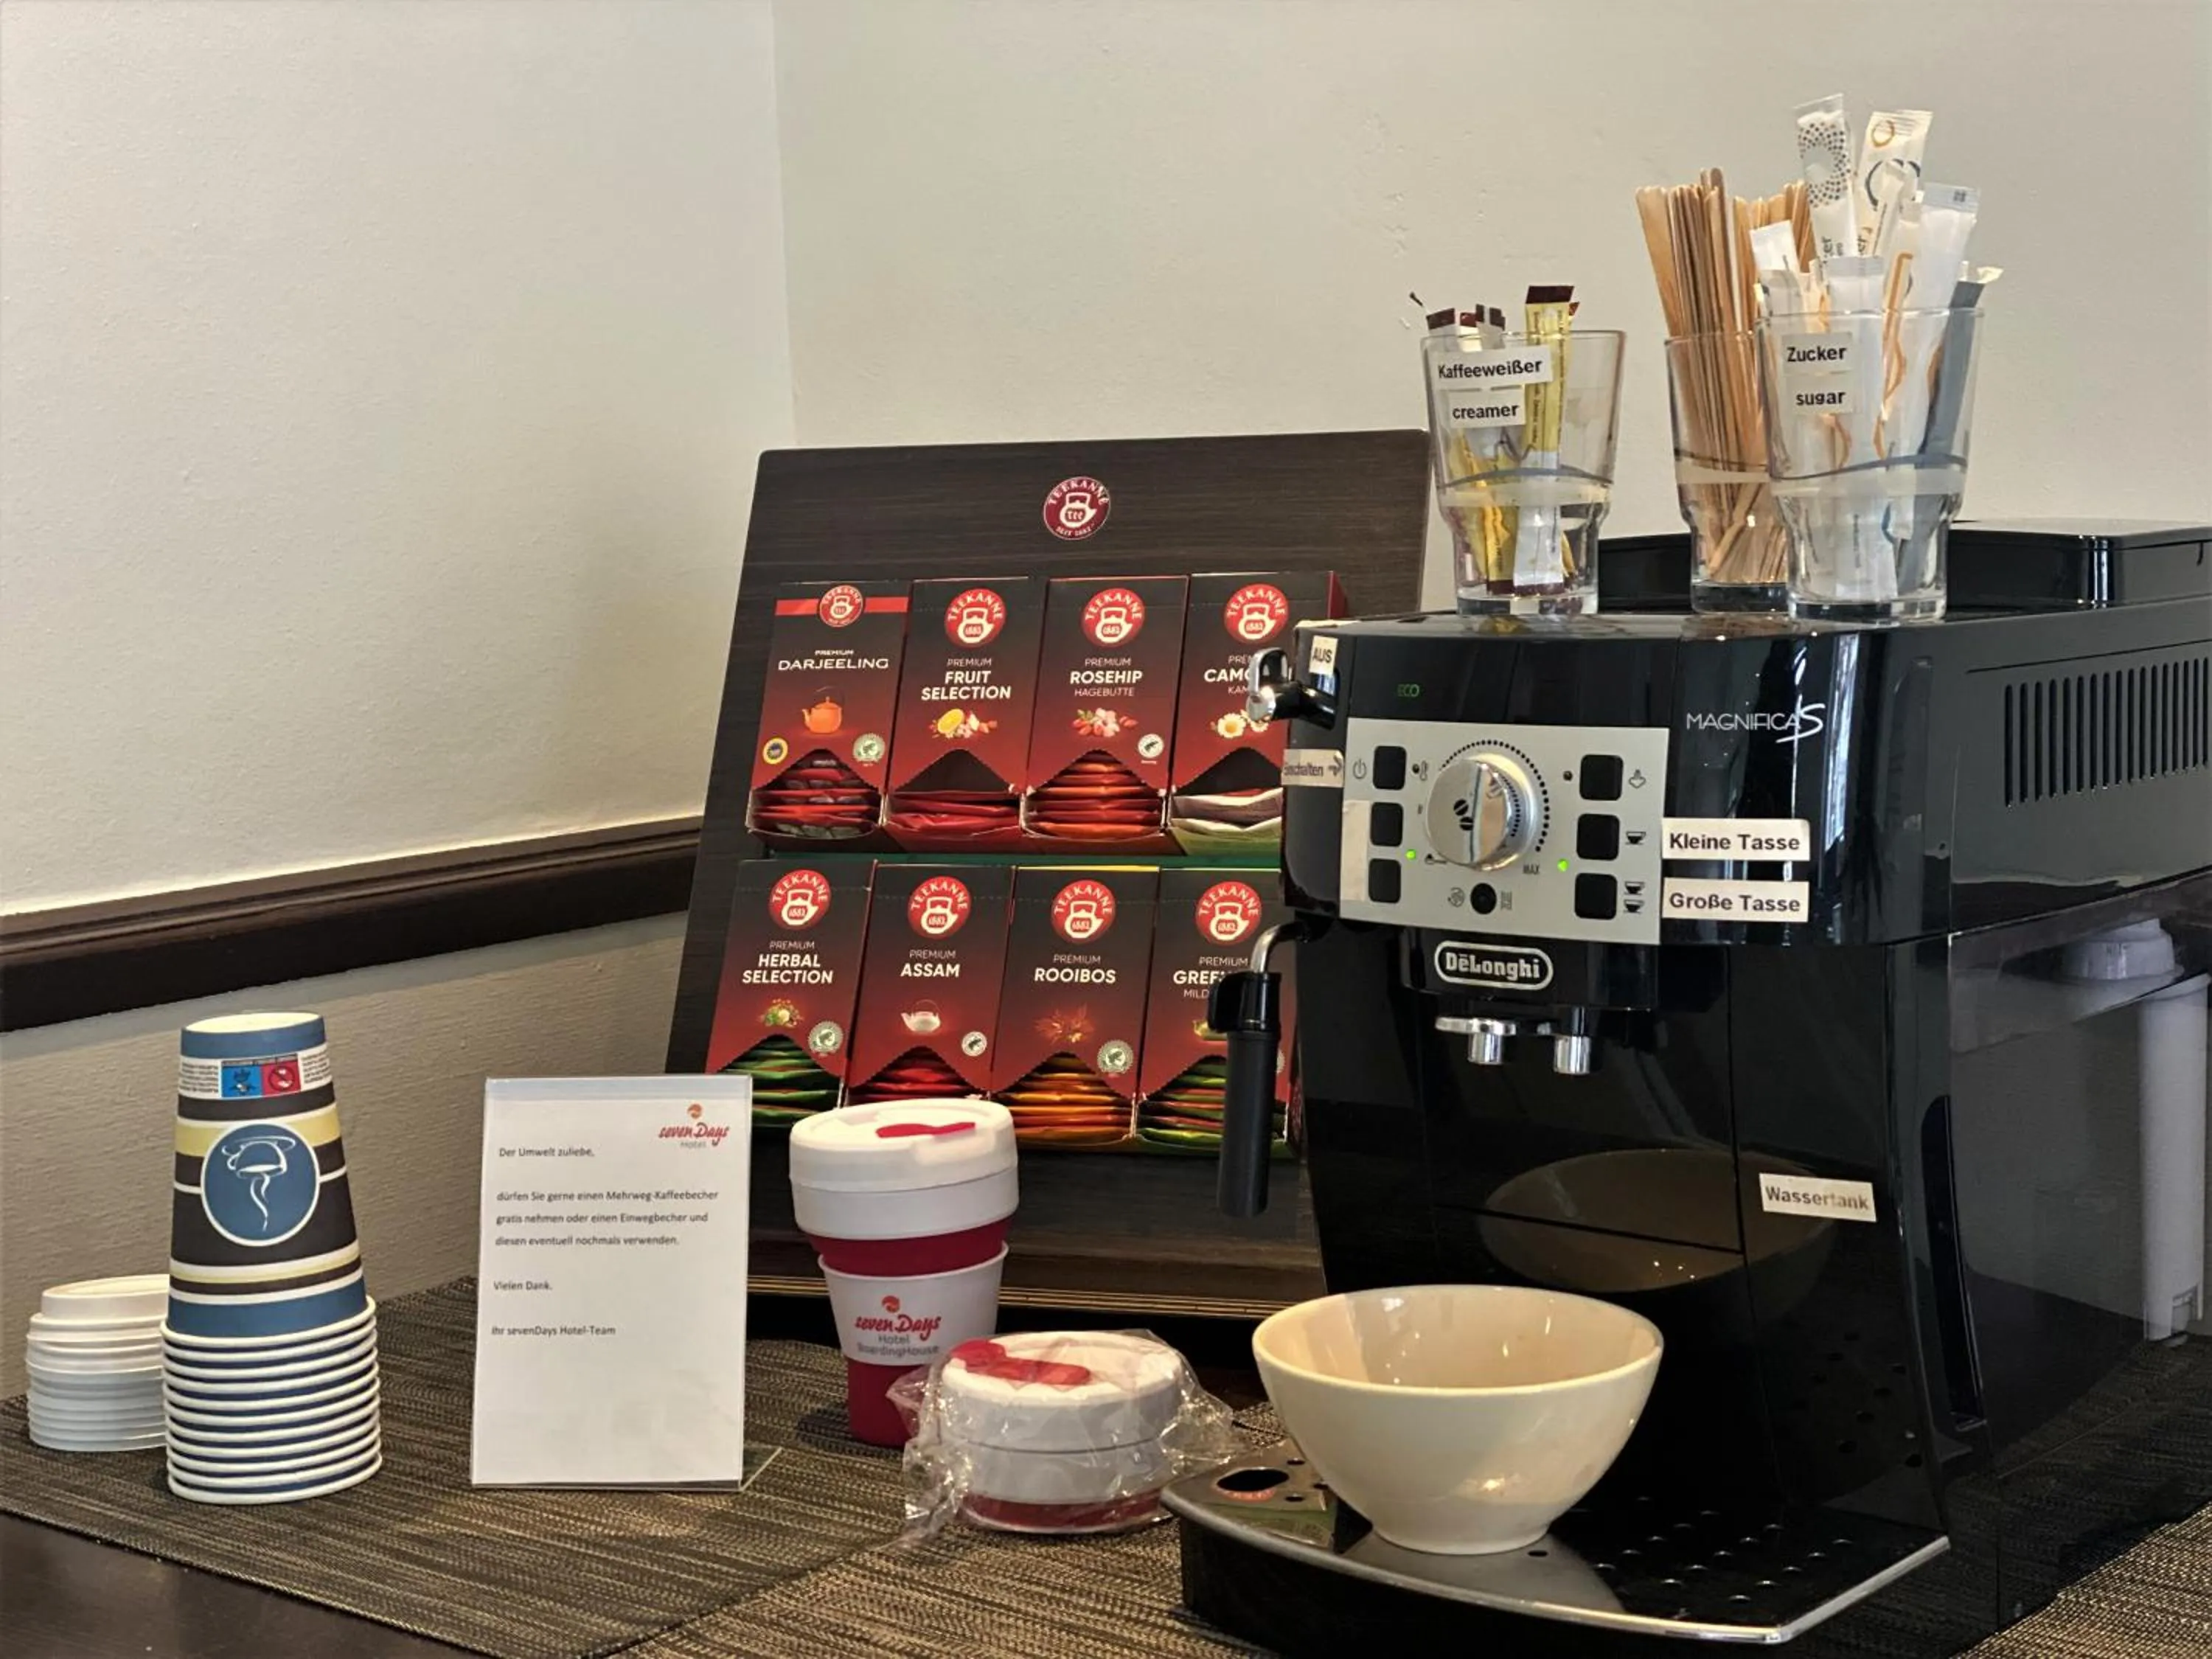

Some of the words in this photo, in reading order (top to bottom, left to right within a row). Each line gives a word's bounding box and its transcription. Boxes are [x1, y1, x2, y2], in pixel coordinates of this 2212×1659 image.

[1787, 345, 1847, 363] Zucker
[1439, 360, 1543, 379] Kaffeeweißer
[1796, 391, 1846, 406] sugar
[1453, 405, 1519, 419] creamer
[1085, 592, 1143, 620] TEEKANNE
[1227, 588, 1286, 617] TEEKANNE
[947, 658, 992, 667] PREMIUM
[1085, 657, 1132, 667] PREMIUM
[1312, 647, 1333, 664] AUS
[777, 658, 889, 671] DARJEELING
[945, 670, 992, 684] FRUIT
[1070, 670, 1144, 685] ROSEHIP
[921, 686, 1012, 700] SELECTION
[1074, 686, 1135, 697] HAGEBUTTE
[1397, 684, 1420, 698] ECO
[1686, 712, 1801, 731] MAGNIFICA
[1669, 832, 1731, 850] Kleine
[1737, 834, 1801, 850] Tasse
[773, 873, 828, 904] TEEKANNE
[911, 880, 968, 911] TEEKANNE
[1054, 883, 1113, 916] TEEKANNE
[1199, 886, 1259, 917] TEEKANNE
[1669, 892, 1733, 911] Große
[1738, 894, 1801, 912] Tasse
[769, 941, 815, 950] PREMIUM
[758, 953, 821, 968] HERBAL
[908, 950, 956, 959] PREMIUM
[1053, 954, 1102, 964] PREMIUM
[1198, 956, 1248, 967] PREMIUM
[742, 970, 833, 984] SELECTION
[900, 963, 960, 978] ASSAM
[1034, 967, 1117, 984] ROOIBOS
[499, 1147, 516, 1157] Der
[518, 1147, 555, 1157] Umwelt
[557, 1147, 595, 1158] zuliebe,
[496, 1190, 529, 1201] dürfen
[531, 1191, 546, 1201] Sie
[547, 1192, 574, 1203] gerne
[577, 1191, 604, 1201] einen
[605, 1189, 719, 1203] Mehrweg-Kaffeebecher
[1765, 1186, 1870, 1211] Wassertank
[495, 1213, 523, 1225] gratis
[524, 1213, 564, 1223] nehmen
[566, 1213, 589, 1223] oder
[591, 1214, 617, 1223] einen
[620, 1212, 687, 1224] Einwegbecher
[689, 1212, 709, 1222] und
[495, 1235, 527, 1246] diesen
[529, 1235, 573, 1246] eventuell
[575, 1235, 621, 1246] nochmals
[623, 1235, 680, 1245] verwenden.
[493, 1280, 524, 1290] Vielen
[526, 1280, 553, 1291] Dank.
[492, 1326, 504, 1336] Ihr
[507, 1325, 557, 1338] sevenDays
[560, 1325, 616, 1336] Hotel-Team
[877, 1334, 910, 1344] Hotel
